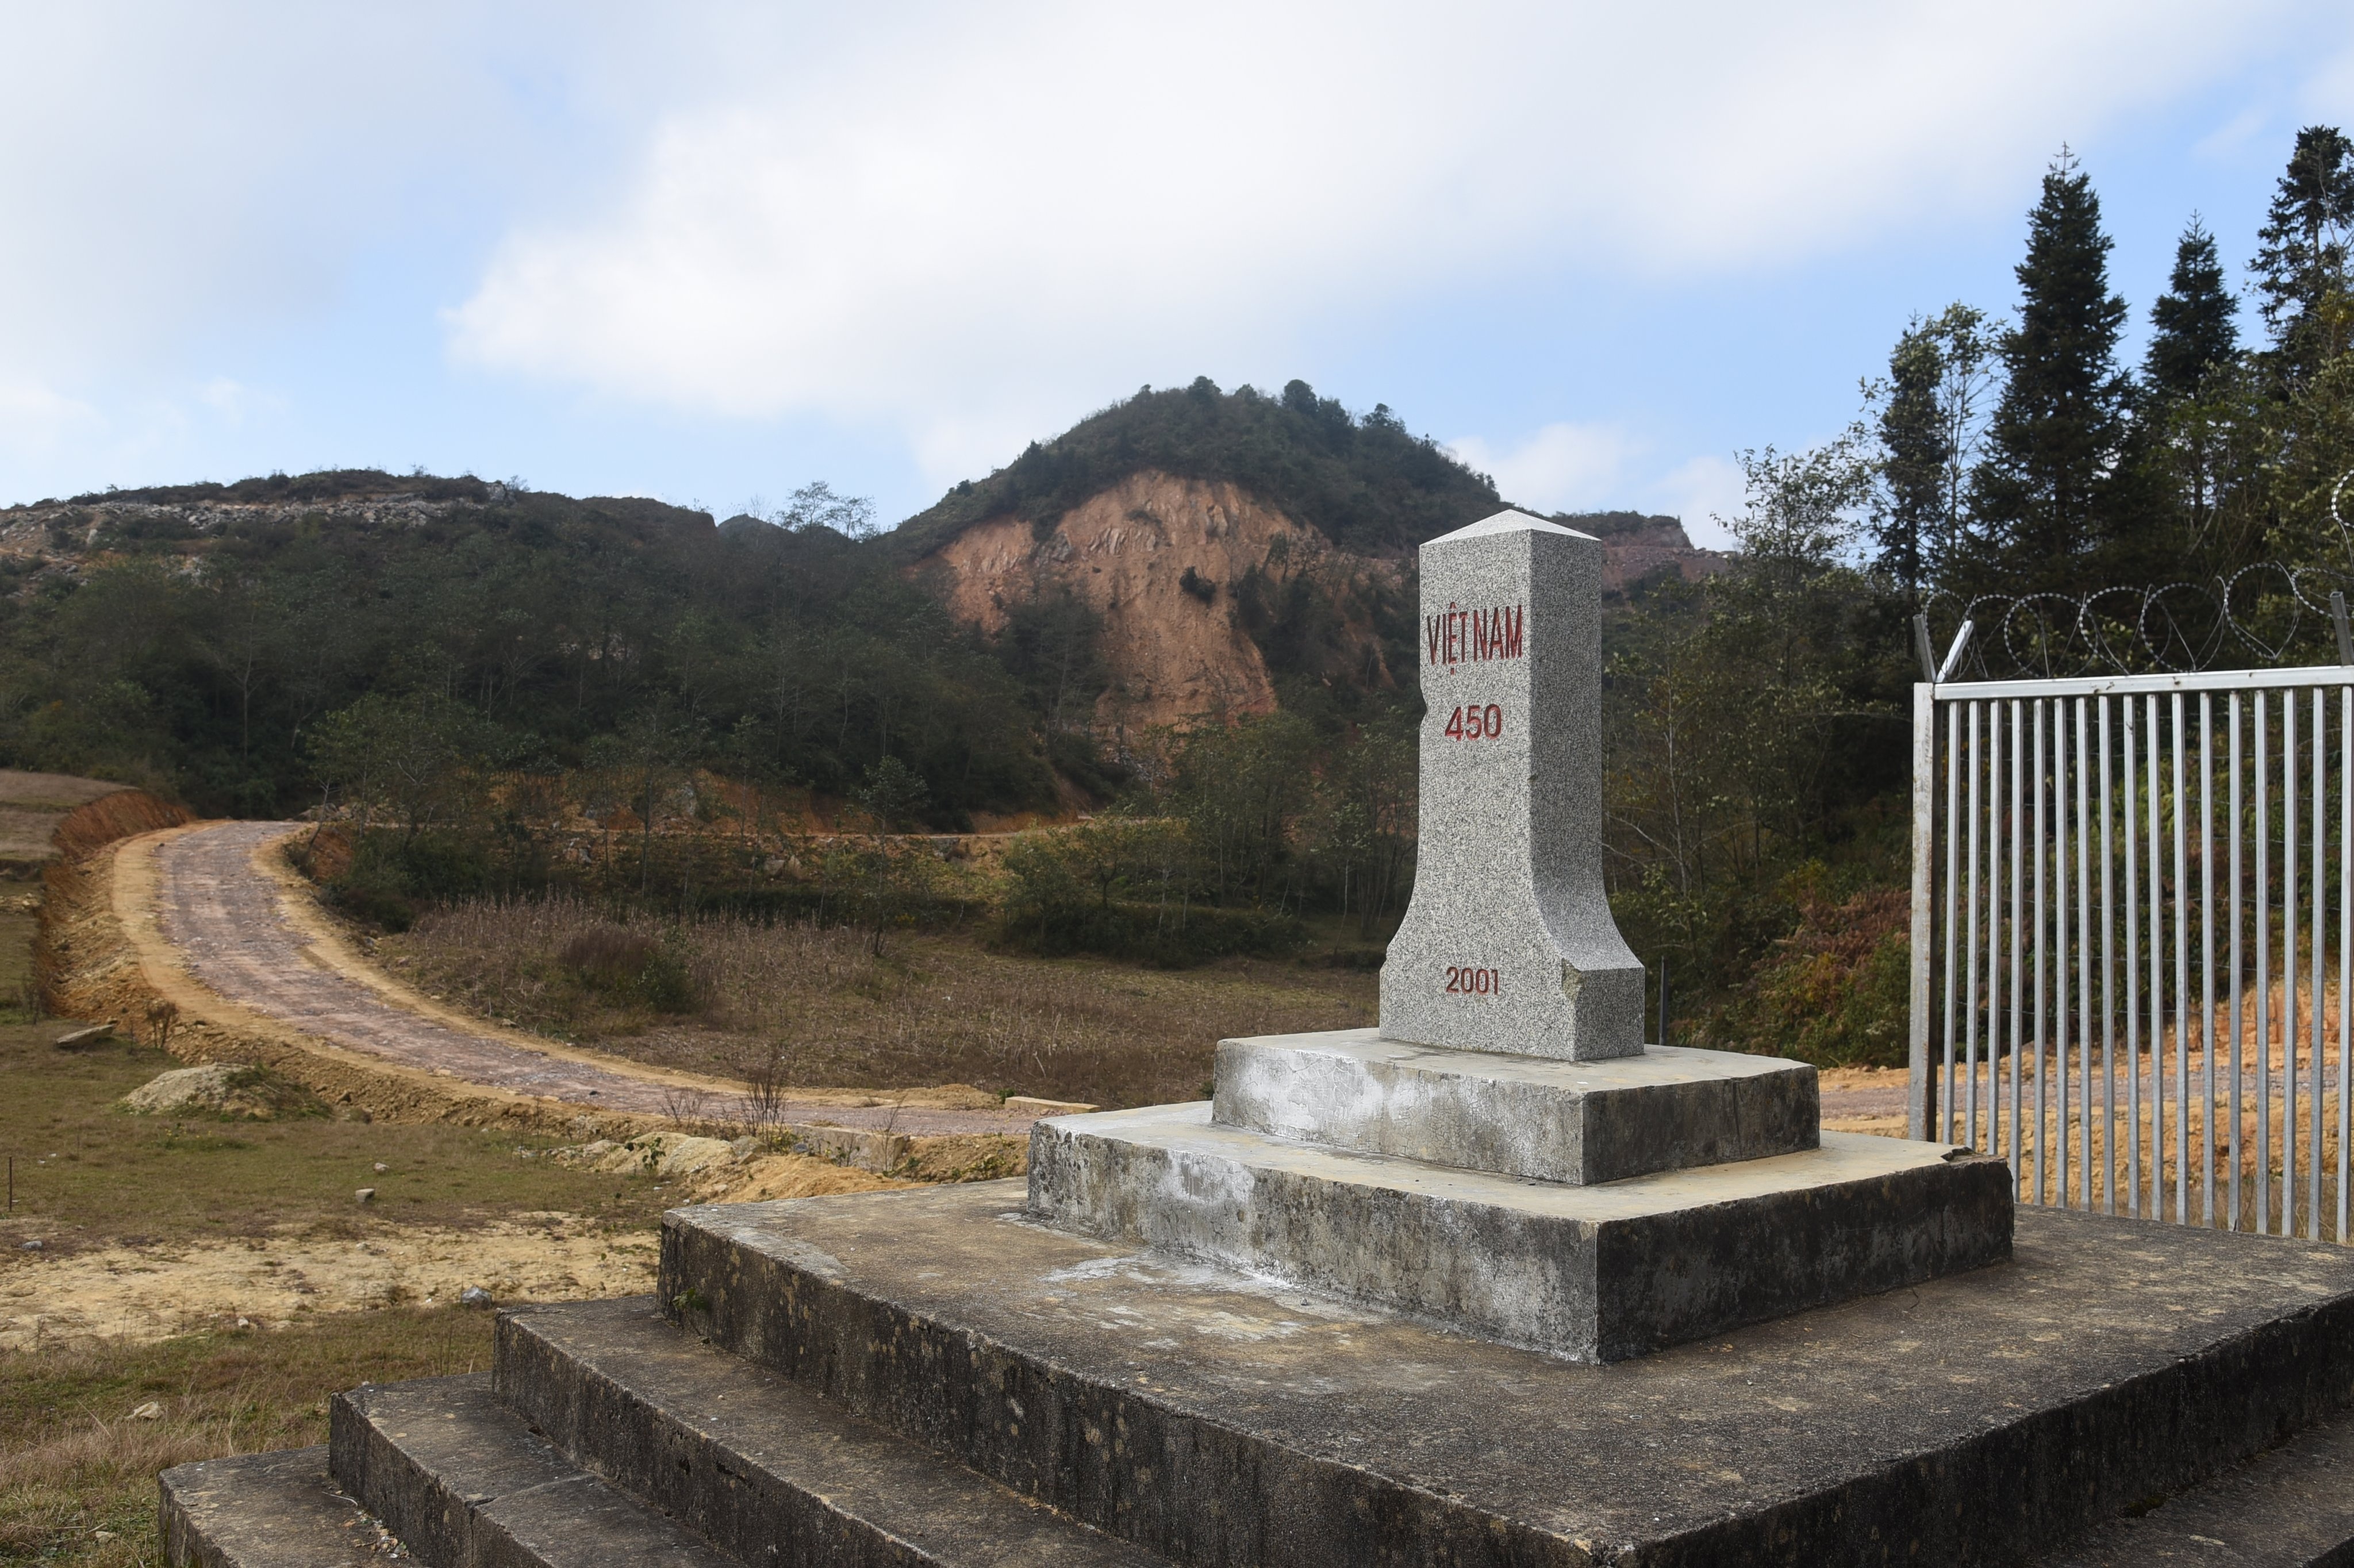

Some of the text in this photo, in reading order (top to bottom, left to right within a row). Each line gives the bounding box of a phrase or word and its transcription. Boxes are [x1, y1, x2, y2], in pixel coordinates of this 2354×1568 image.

[1473, 605, 1522, 662] NAM
[1445, 704, 1502, 741] 450
[1446, 966, 1498, 996] 2001
